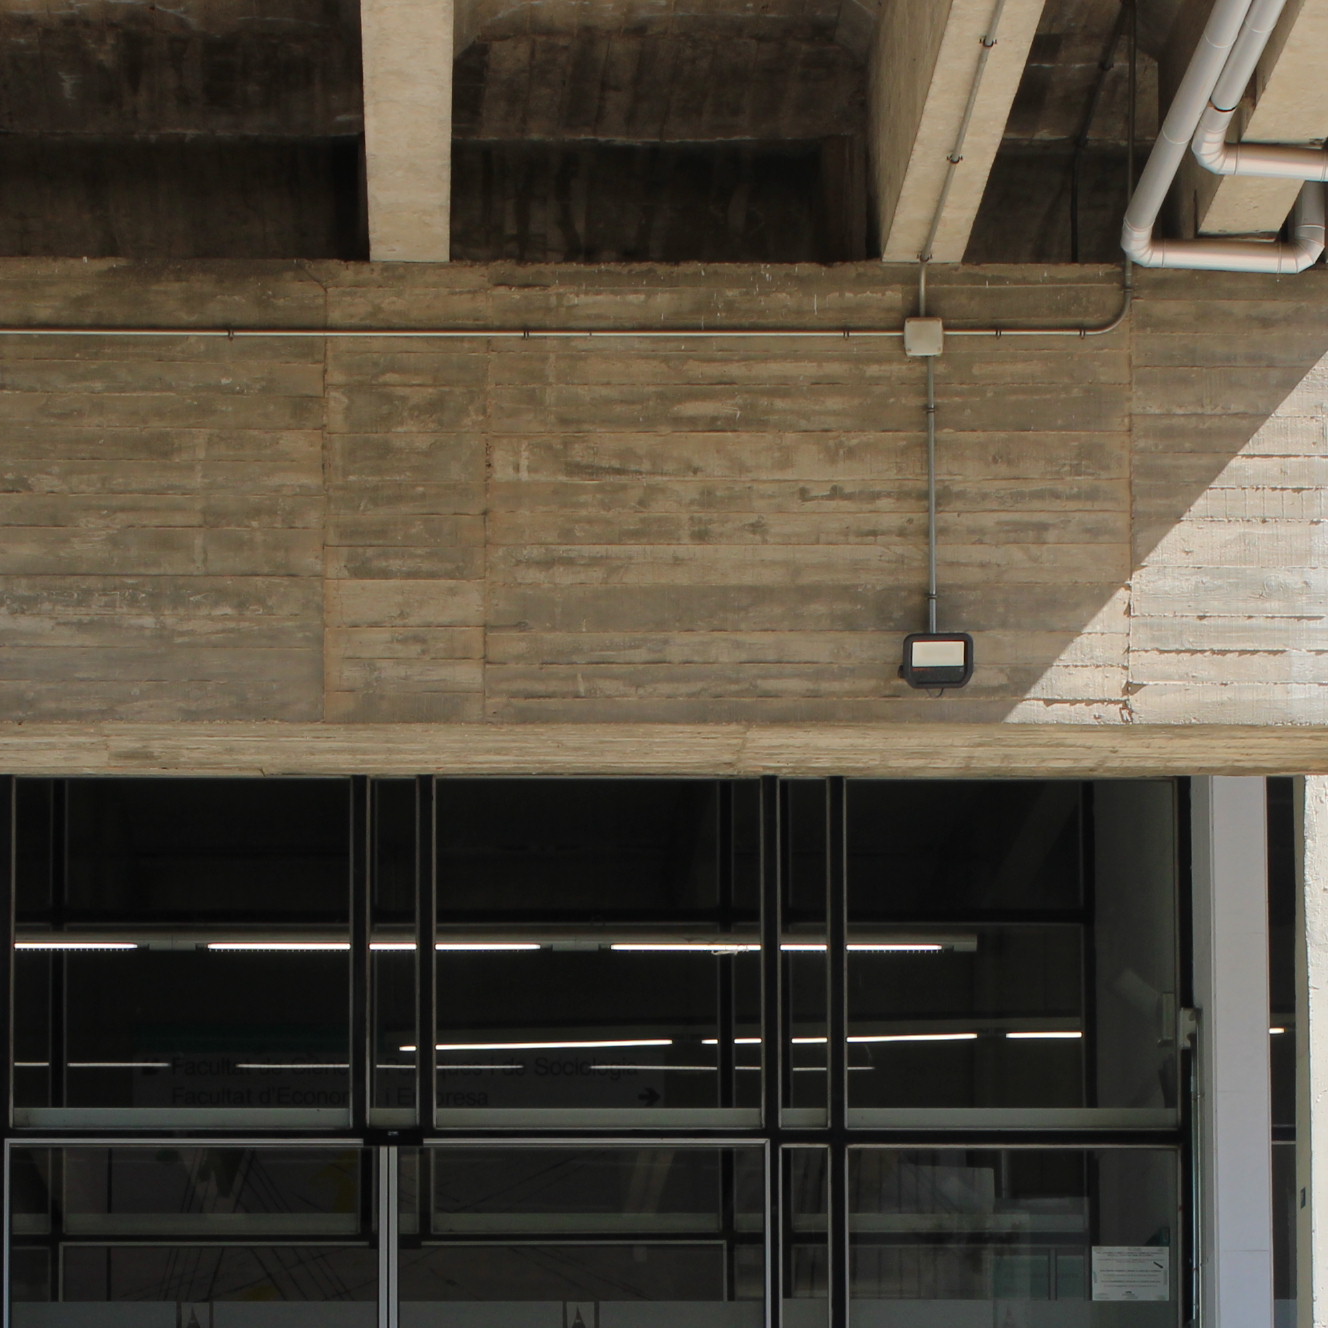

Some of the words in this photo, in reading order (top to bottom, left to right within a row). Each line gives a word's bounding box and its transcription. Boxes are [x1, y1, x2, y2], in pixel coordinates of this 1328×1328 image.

[171, 1056, 252, 1076] Facultat
[534, 1056, 638, 1081] Sociologia
[171, 1086, 252, 1106] Facultat
